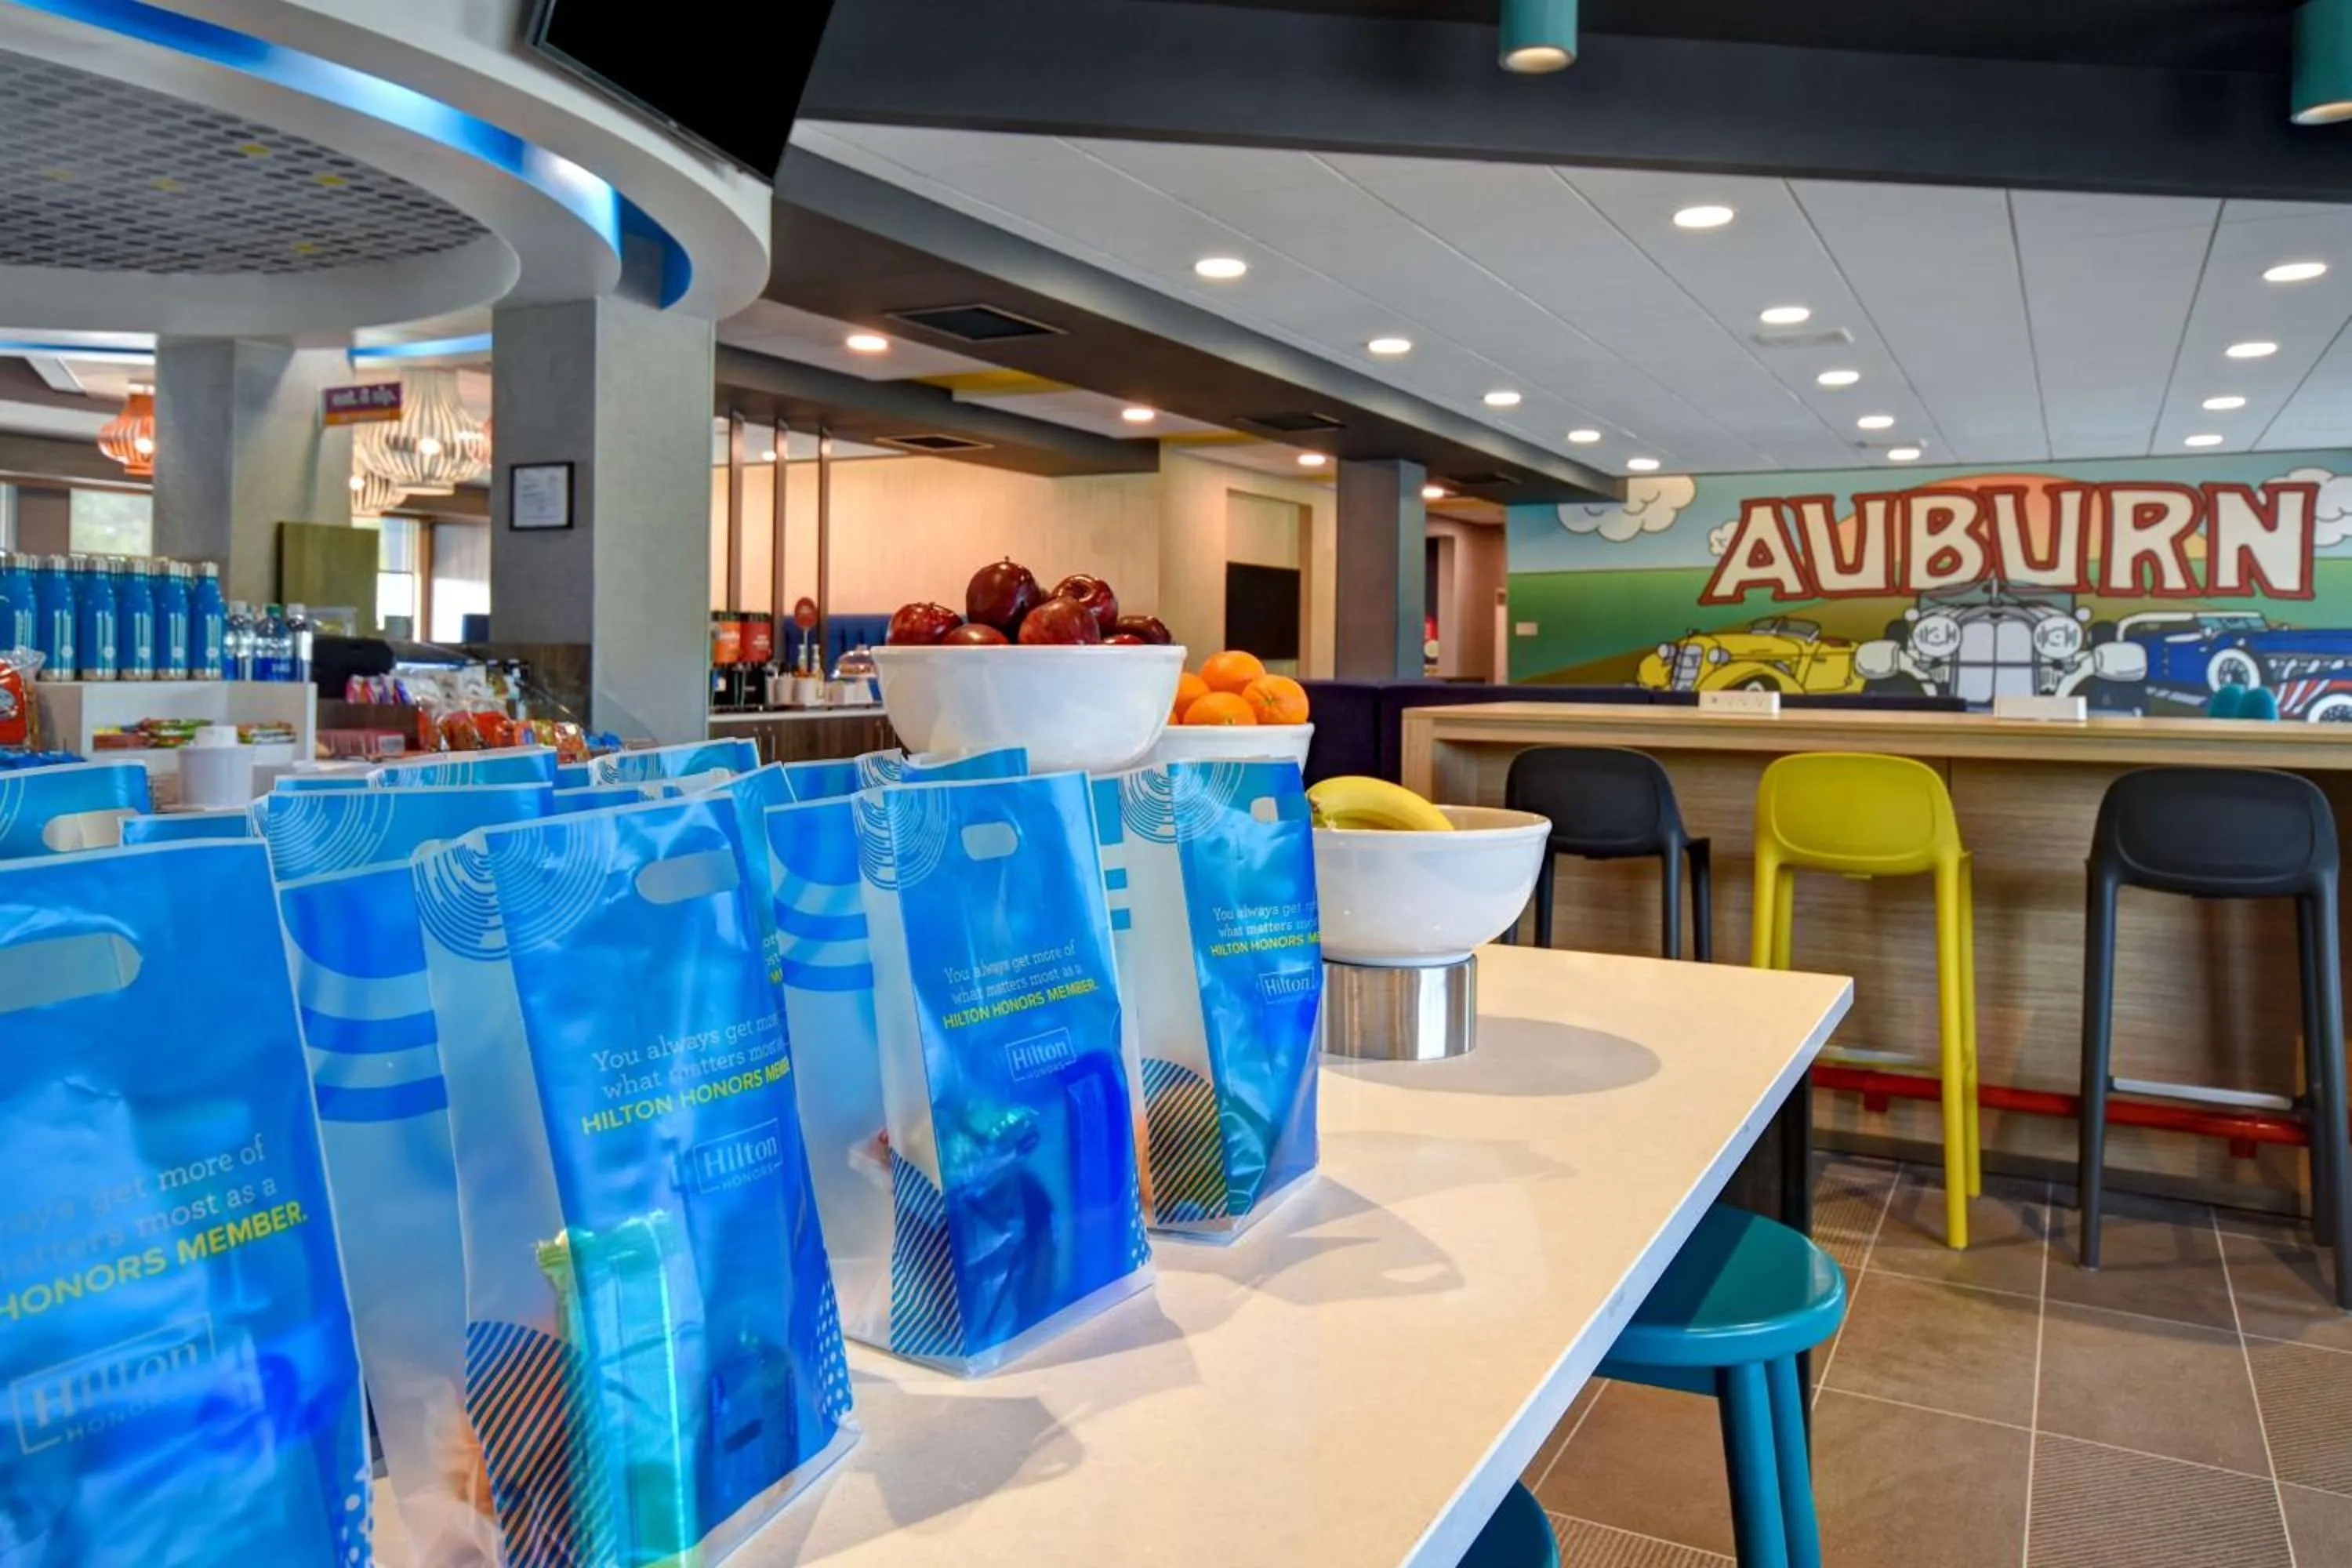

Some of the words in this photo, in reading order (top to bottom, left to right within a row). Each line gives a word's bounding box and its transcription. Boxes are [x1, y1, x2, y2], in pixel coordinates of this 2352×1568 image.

[1697, 481, 2321, 605] AUBURN
[1212, 906, 1234, 921] You
[1236, 903, 1279, 920] always
[1218, 924, 1243, 938] what
[1246, 921, 1293, 936] matters
[944, 966, 971, 985] You
[972, 957, 1011, 978] always
[1011, 953, 1031, 972] get
[1033, 949, 1062, 964] more
[1063, 938, 1076, 956] of
[1210, 942, 1249, 956] HILTON
[1250, 934, 1305, 951] HONORS
[951, 985, 983, 1004] what
[985, 976, 1028, 997] matters
[1029, 967, 1060, 985] most
[1062, 964, 1075, 978] as
[1075, 964, 1083, 975] a
[1265, 976, 1310, 997] Hilton
[942, 1004, 990, 1029] HILTON
[992, 991, 1045, 1017] HONORS
[591, 1048, 641, 1072] You
[647, 1029, 720, 1058] always
[724, 1020, 753, 1044] get
[1012, 1040, 1069, 1071] Hilton
[601, 1070, 662, 1100] what
[668, 1051, 746, 1083] matters
[581, 1094, 674, 1135] HILTON
[679, 1069, 764, 1109] HONORS
[158, 1152, 234, 1192] more
[239, 1133, 267, 1166] of
[704, 1136, 778, 1178] Hilton
[136, 1194, 219, 1239] most
[226, 1184, 256, 1208] as
[261, 1178, 278, 1197] a
[176, 1200, 308, 1266] MEMBER.
[32, 1341, 198, 1428] Hilton
